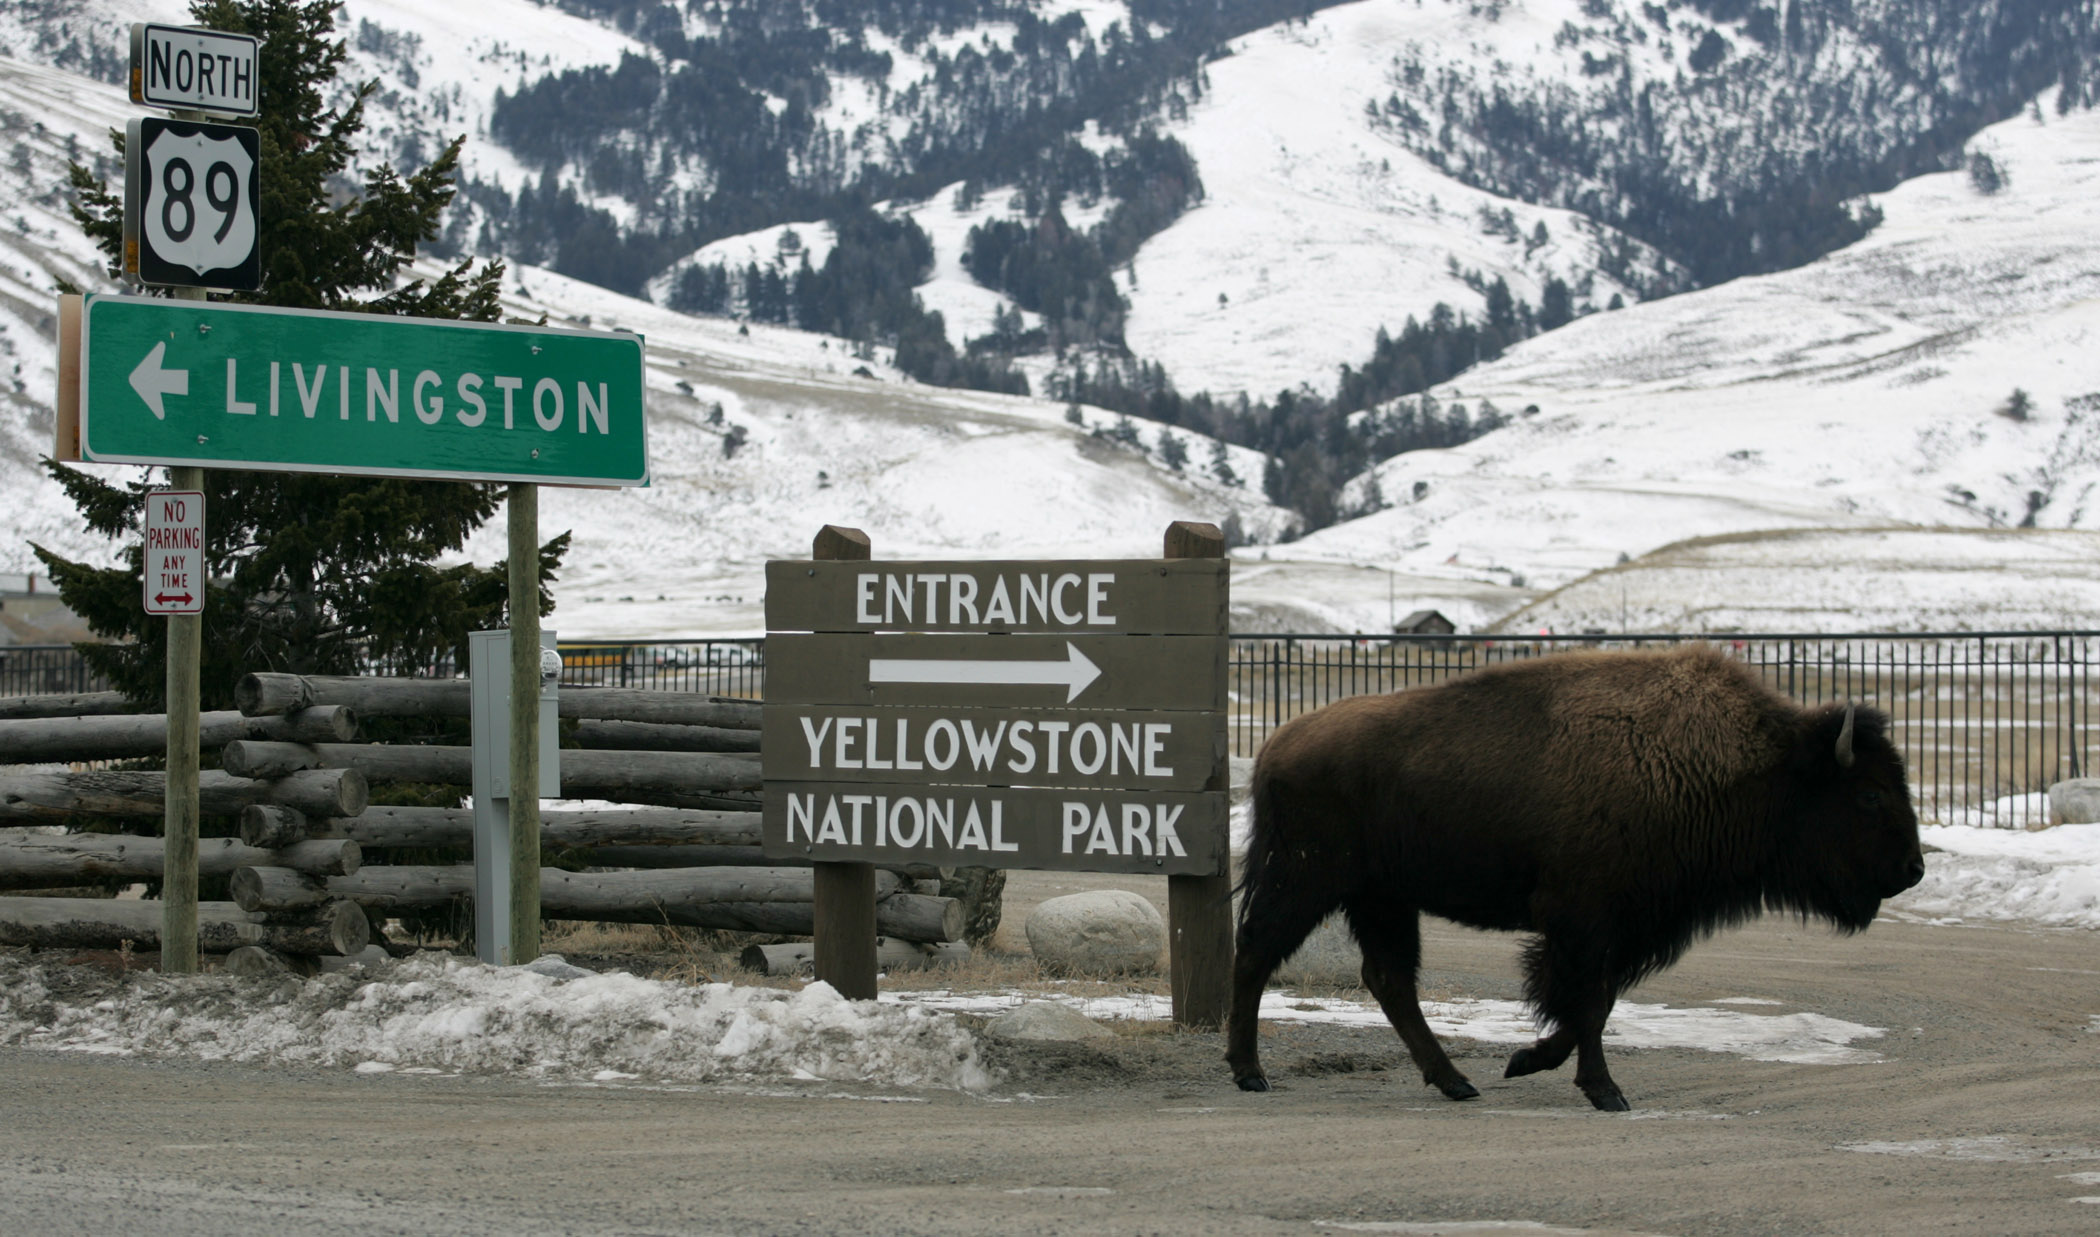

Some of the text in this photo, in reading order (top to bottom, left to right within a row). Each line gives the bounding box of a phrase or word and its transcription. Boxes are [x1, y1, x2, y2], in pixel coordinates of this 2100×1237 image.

[150, 39, 251, 100] NORTH
[162, 157, 240, 245] 89
[226, 357, 610, 435] LIVINGSTON
[149, 527, 200, 549] PARKING
[164, 500, 186, 522] NO
[160, 573, 188, 588] TIME
[163, 555, 186, 570] ANY
[857, 573, 1117, 626] ENTRANCE
[800, 717, 1174, 777] YELLOWSTONE
[787, 793, 1188, 857] NATIONAL PARK
